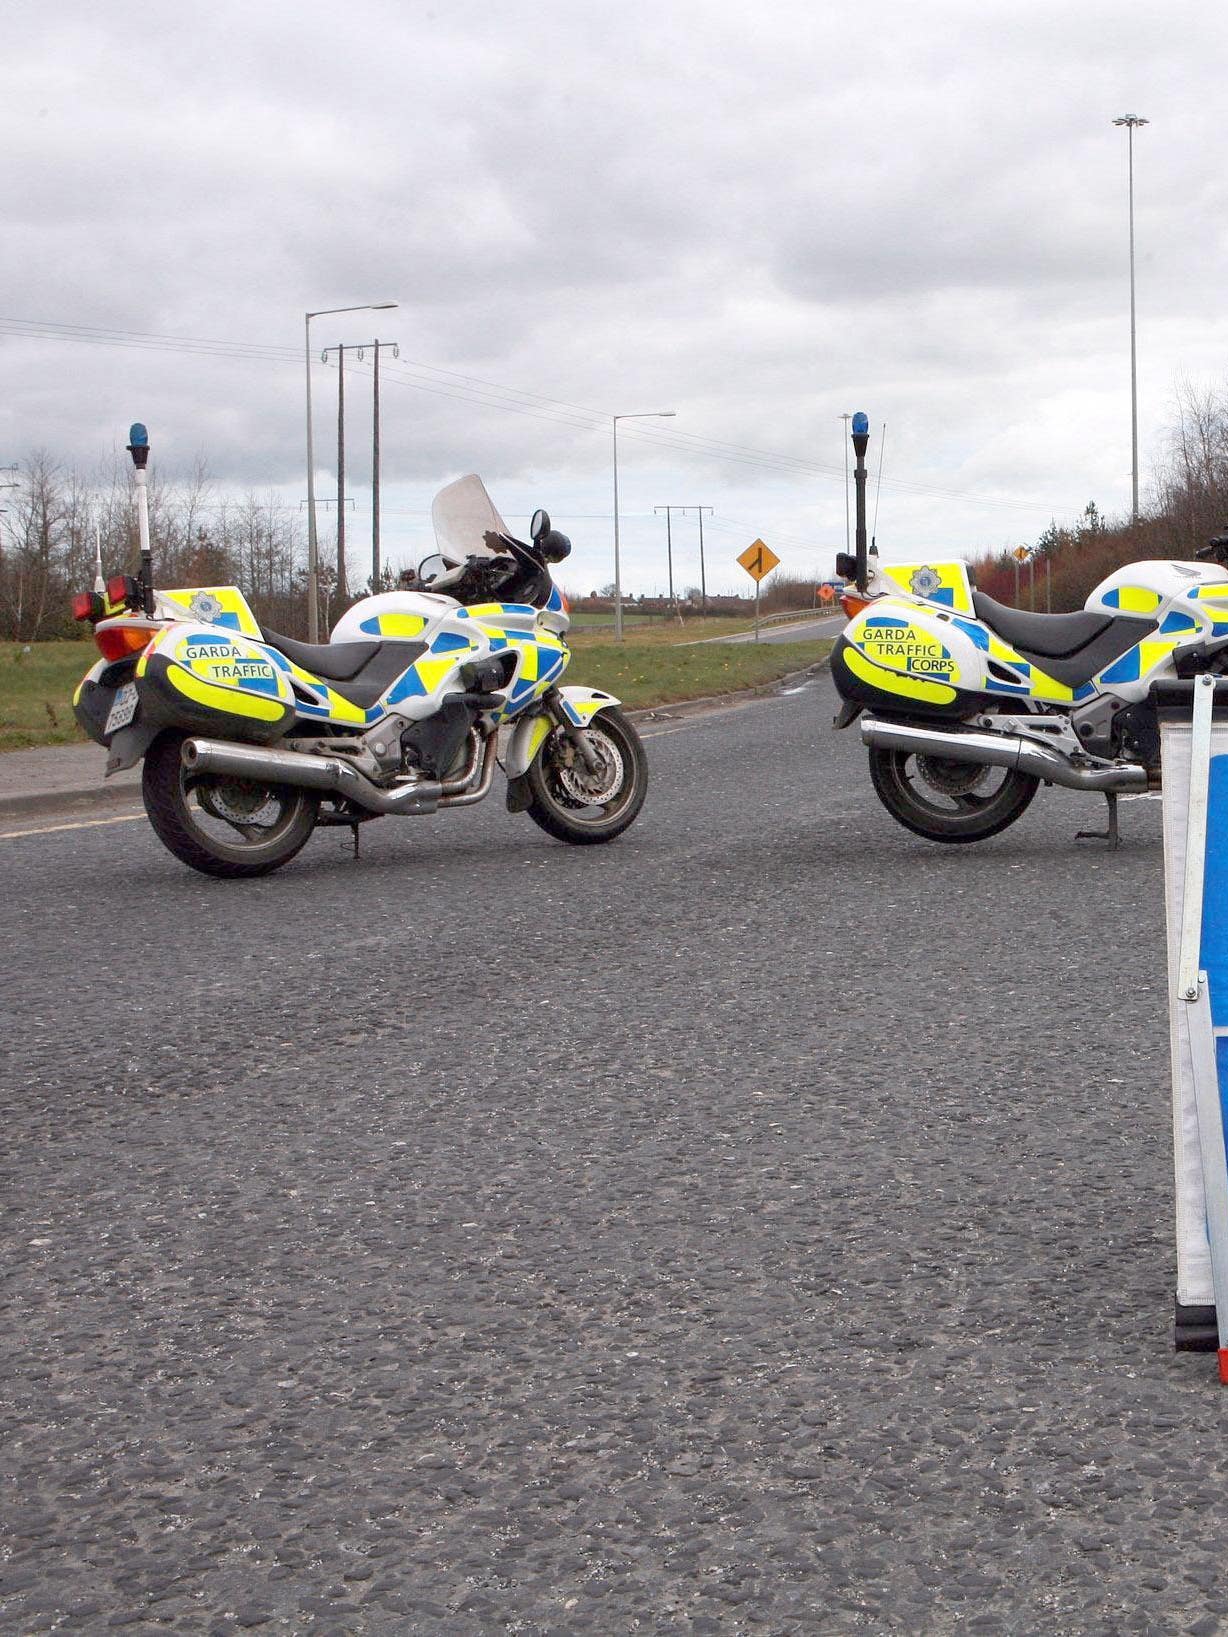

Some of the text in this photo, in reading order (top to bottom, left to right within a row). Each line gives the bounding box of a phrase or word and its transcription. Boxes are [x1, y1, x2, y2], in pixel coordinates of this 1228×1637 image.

[863, 628, 916, 641] GARDA
[186, 646, 242, 659] GARDA
[877, 643, 936, 657] TRAFFIC
[212, 664, 271, 678] TRAFFIC
[911, 658, 955, 672] CORPS
